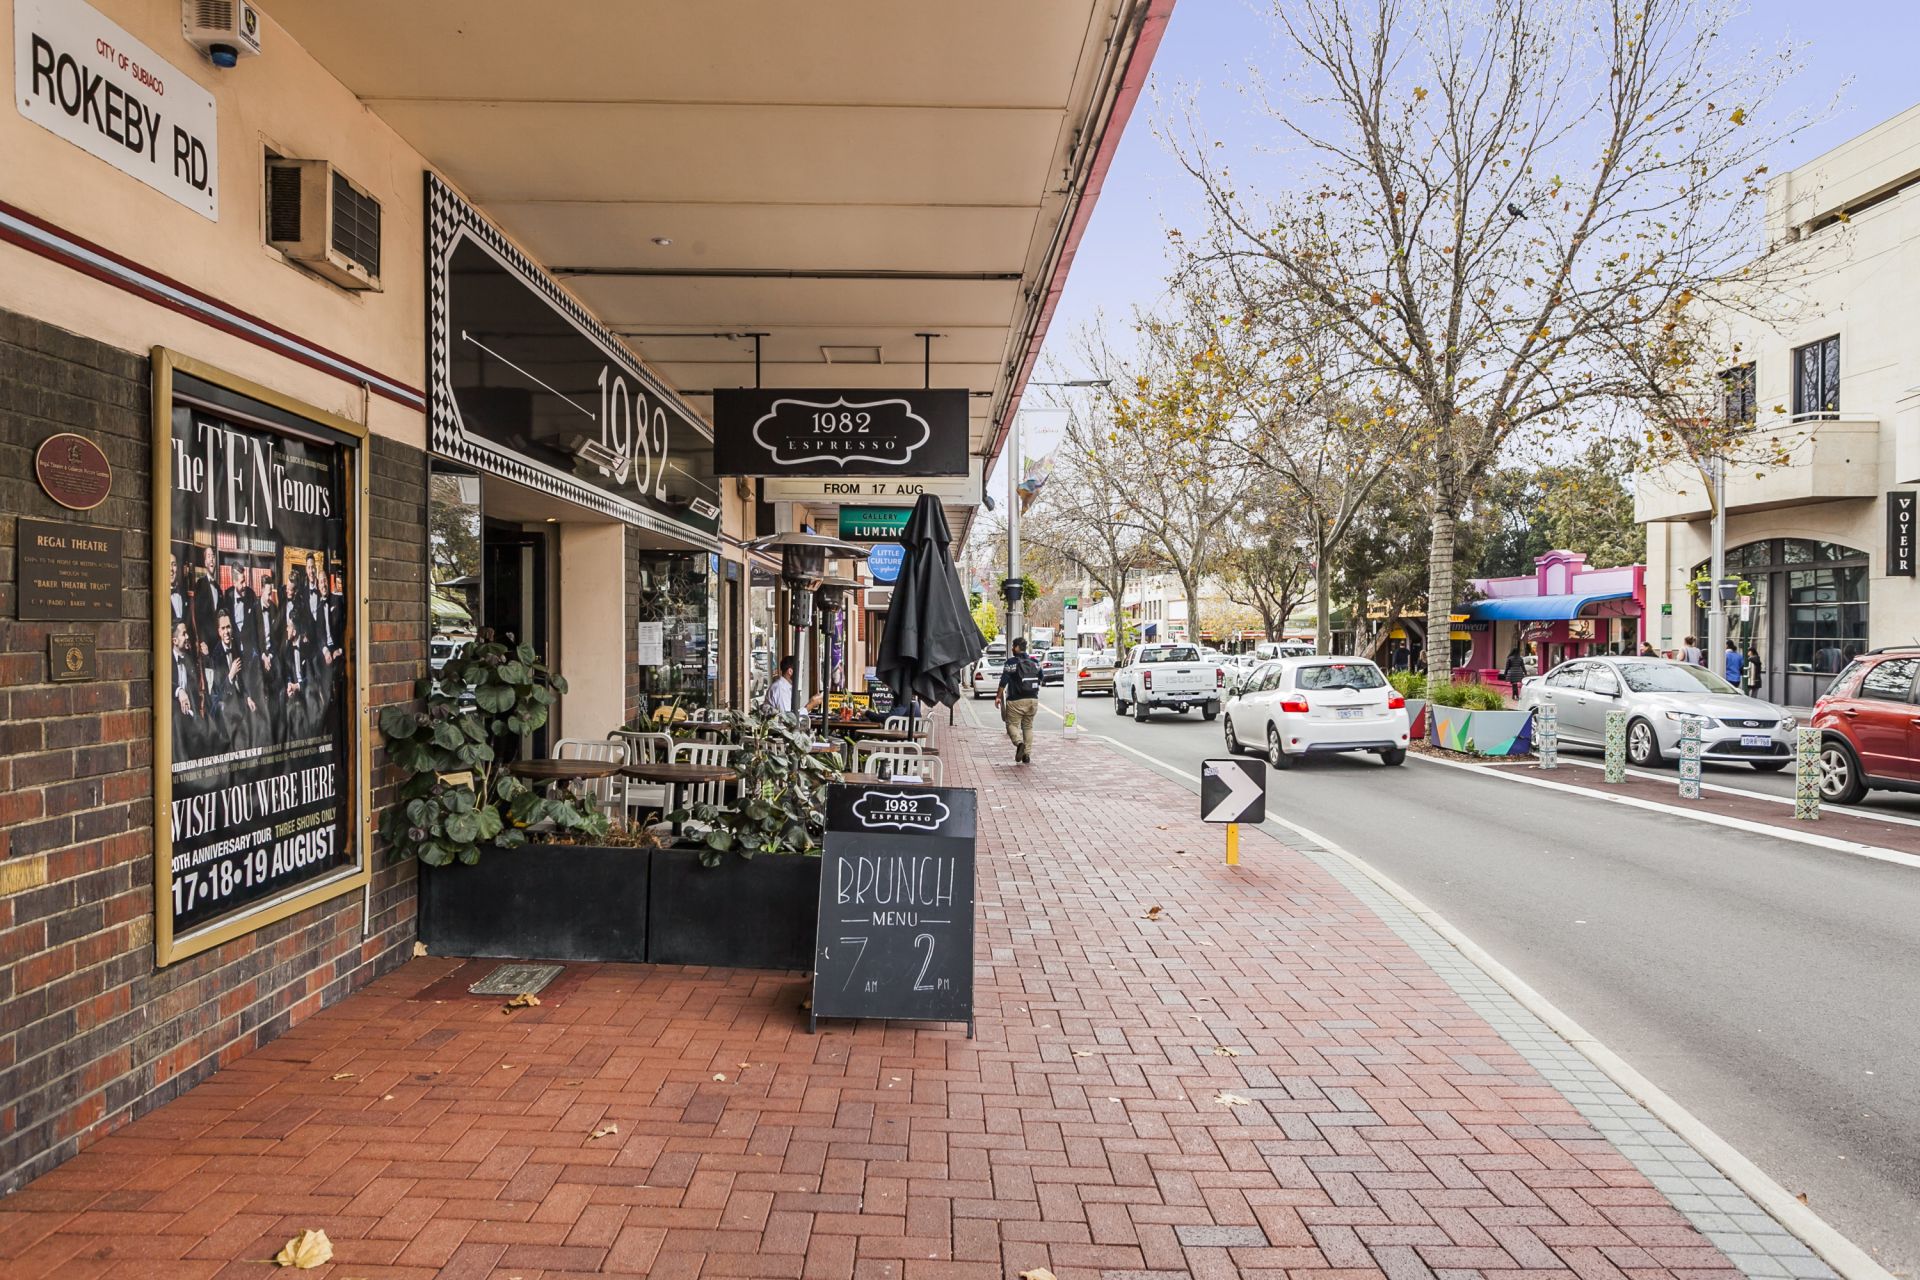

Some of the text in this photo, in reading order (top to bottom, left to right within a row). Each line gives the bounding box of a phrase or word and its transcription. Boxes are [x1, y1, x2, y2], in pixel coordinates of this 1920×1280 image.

[96, 38, 164, 96] CITY OF SUBIACO
[32, 32, 213, 197] ROKEBY RD.
[812, 412, 871, 434] 1982
[789, 440, 895, 450] ESPRESSO
[198, 422, 274, 529] TEN
[273, 463, 330, 517] Tenors
[823, 483, 924, 495] FROM 17 AUG
[37, 535, 108, 552] REGAL THEATRE
[1899, 498, 1911, 570] VOYEUR
[870, 557, 902, 565] CULTURE
[61, 580, 87, 590] THEATRE
[171, 763, 336, 842] WISH YOU WERE HERE
[871, 813, 931, 822] ESPRESSO
[884, 799, 918, 812] 1982
[192, 833, 251, 867] ANNIVERSARY
[251, 827, 272, 846] TOUR
[275, 819, 296, 838] THREE
[297, 812, 321, 831] SHOWS
[321, 807, 337, 824] ONLY
[270, 823, 336, 878] AUGUST
[837, 856, 955, 907] BRUNCH
[872, 911, 918, 927] MENU
[840, 933, 950, 993] 7 AM 2 PM
